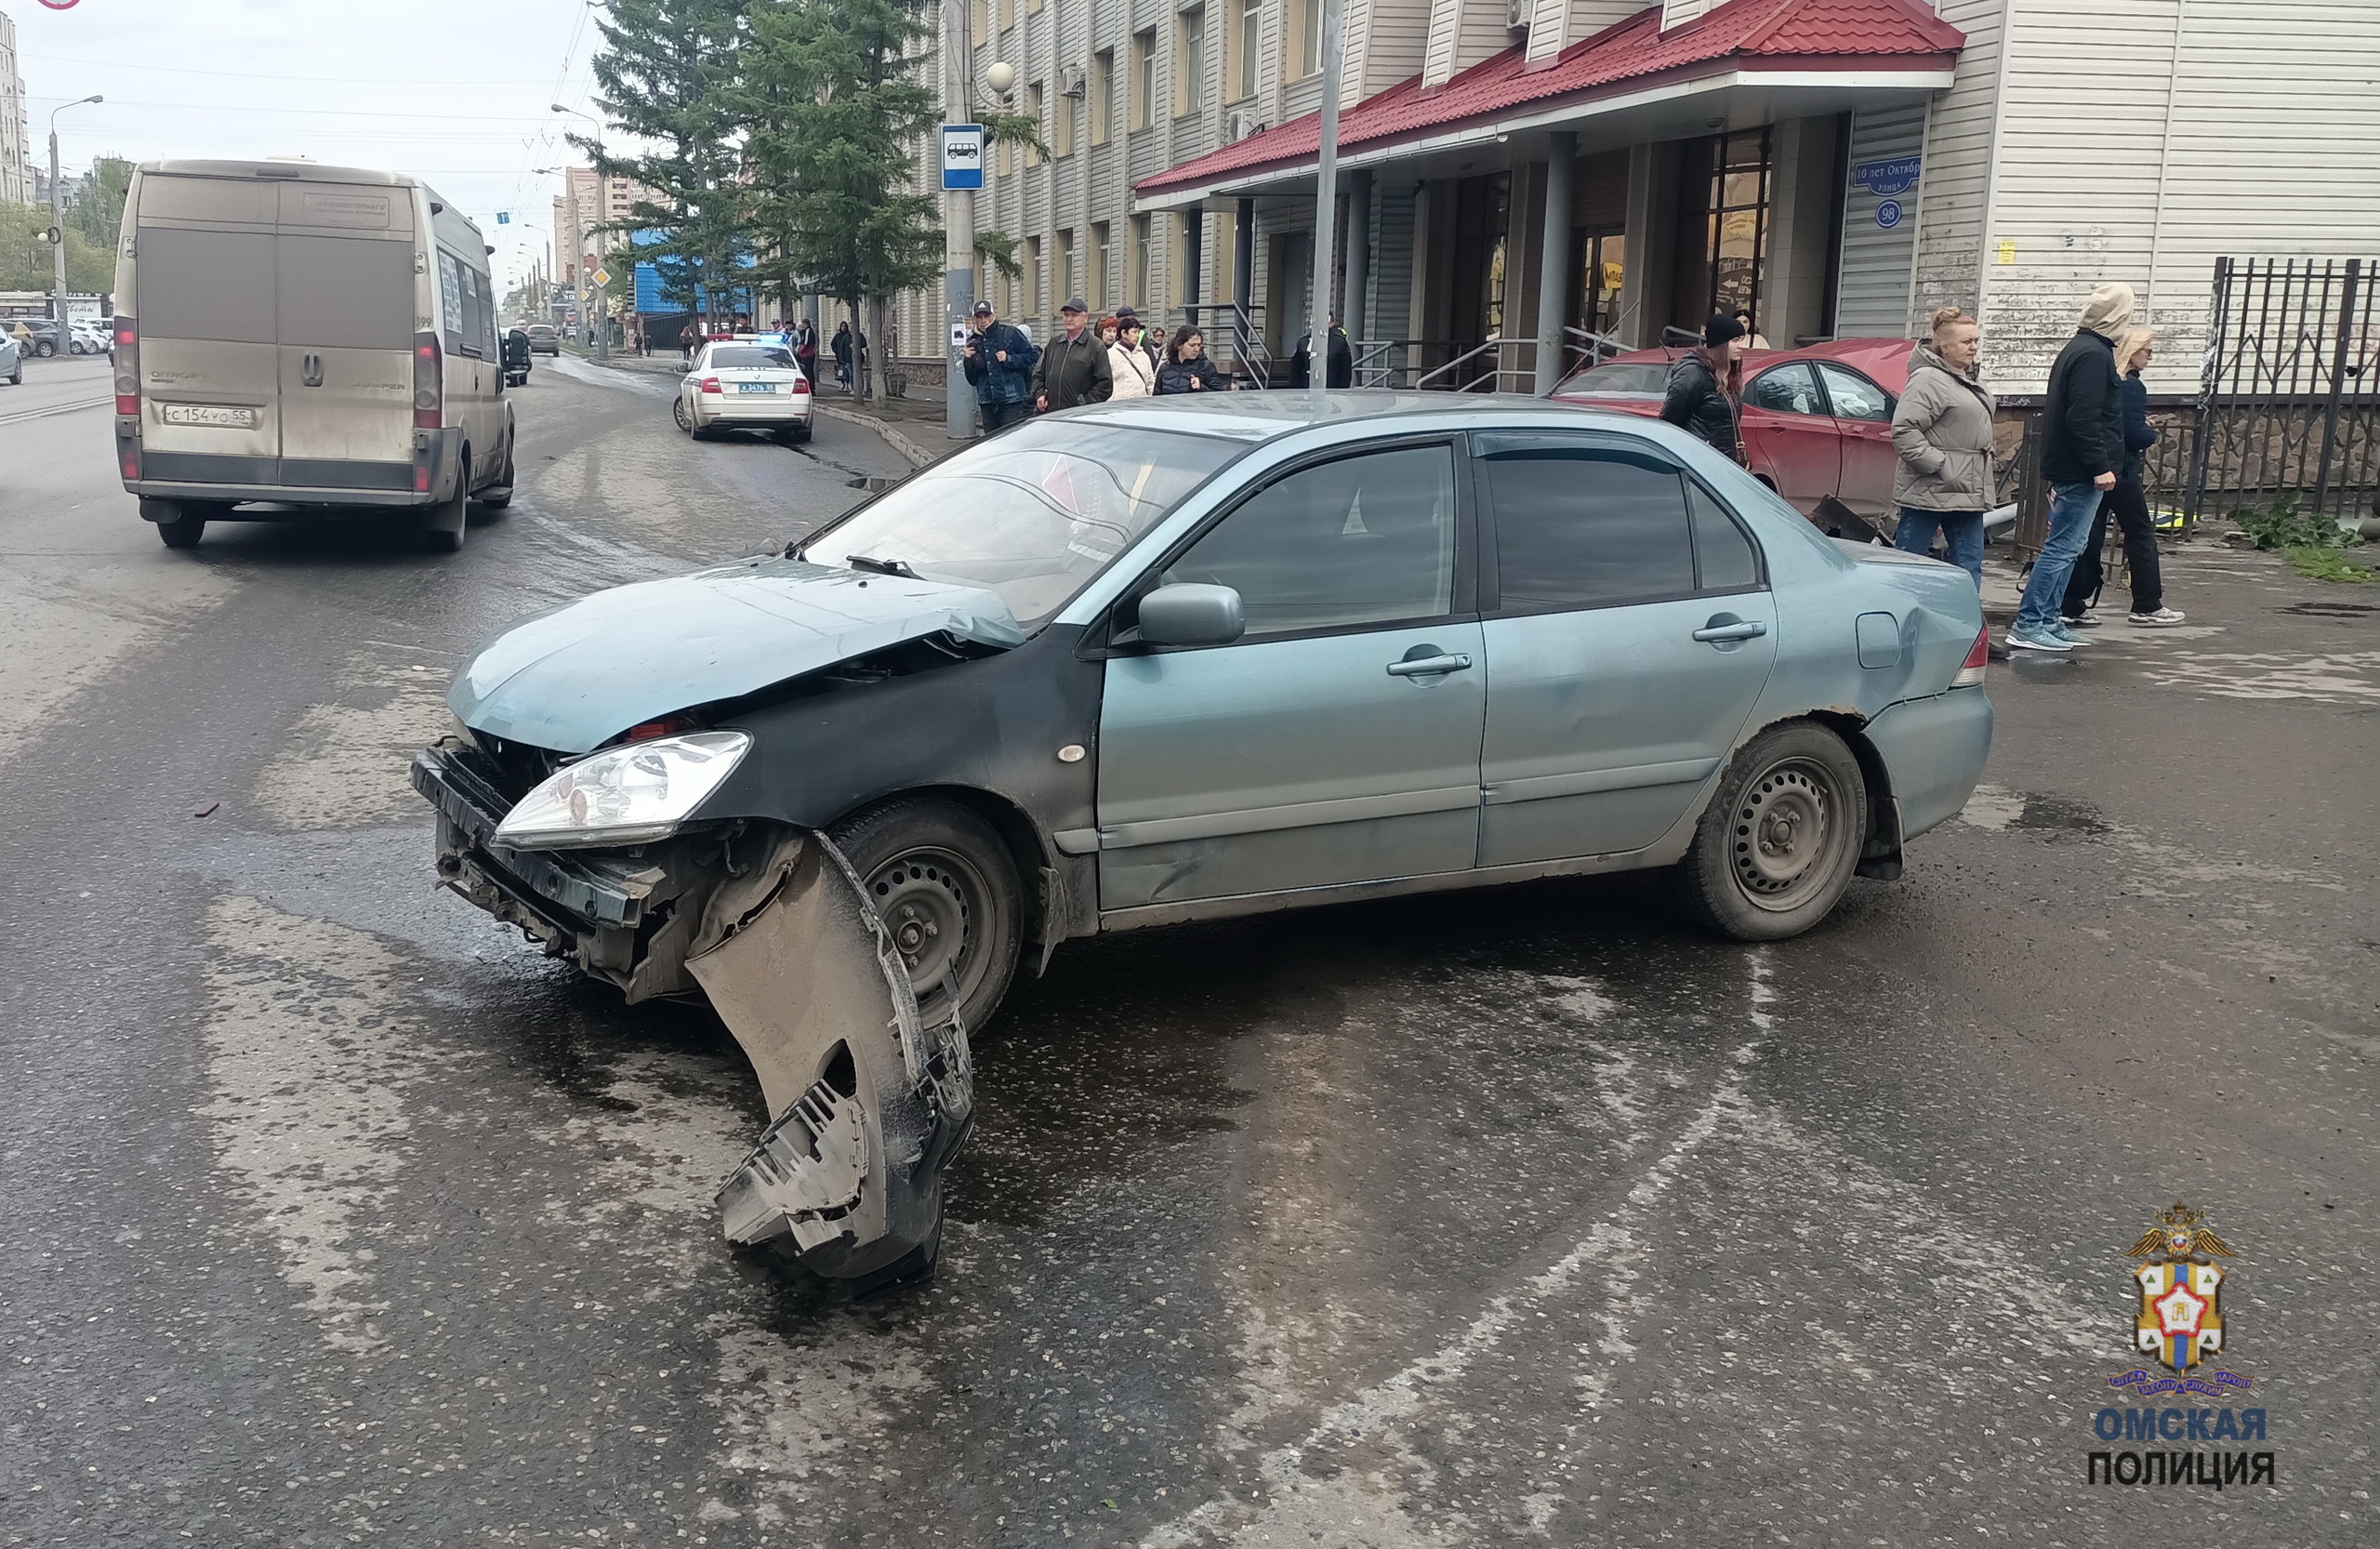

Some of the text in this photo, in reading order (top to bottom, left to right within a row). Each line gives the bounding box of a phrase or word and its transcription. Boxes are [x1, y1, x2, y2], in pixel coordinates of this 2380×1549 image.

[1858, 168, 1867, 179] 10
[1869, 168, 1885, 178] лет
[1882, 207, 1896, 220] 98
[416, 317, 432, 328] 399
[352, 382, 406, 391] JUMPER
[231, 411, 246, 420] 55
